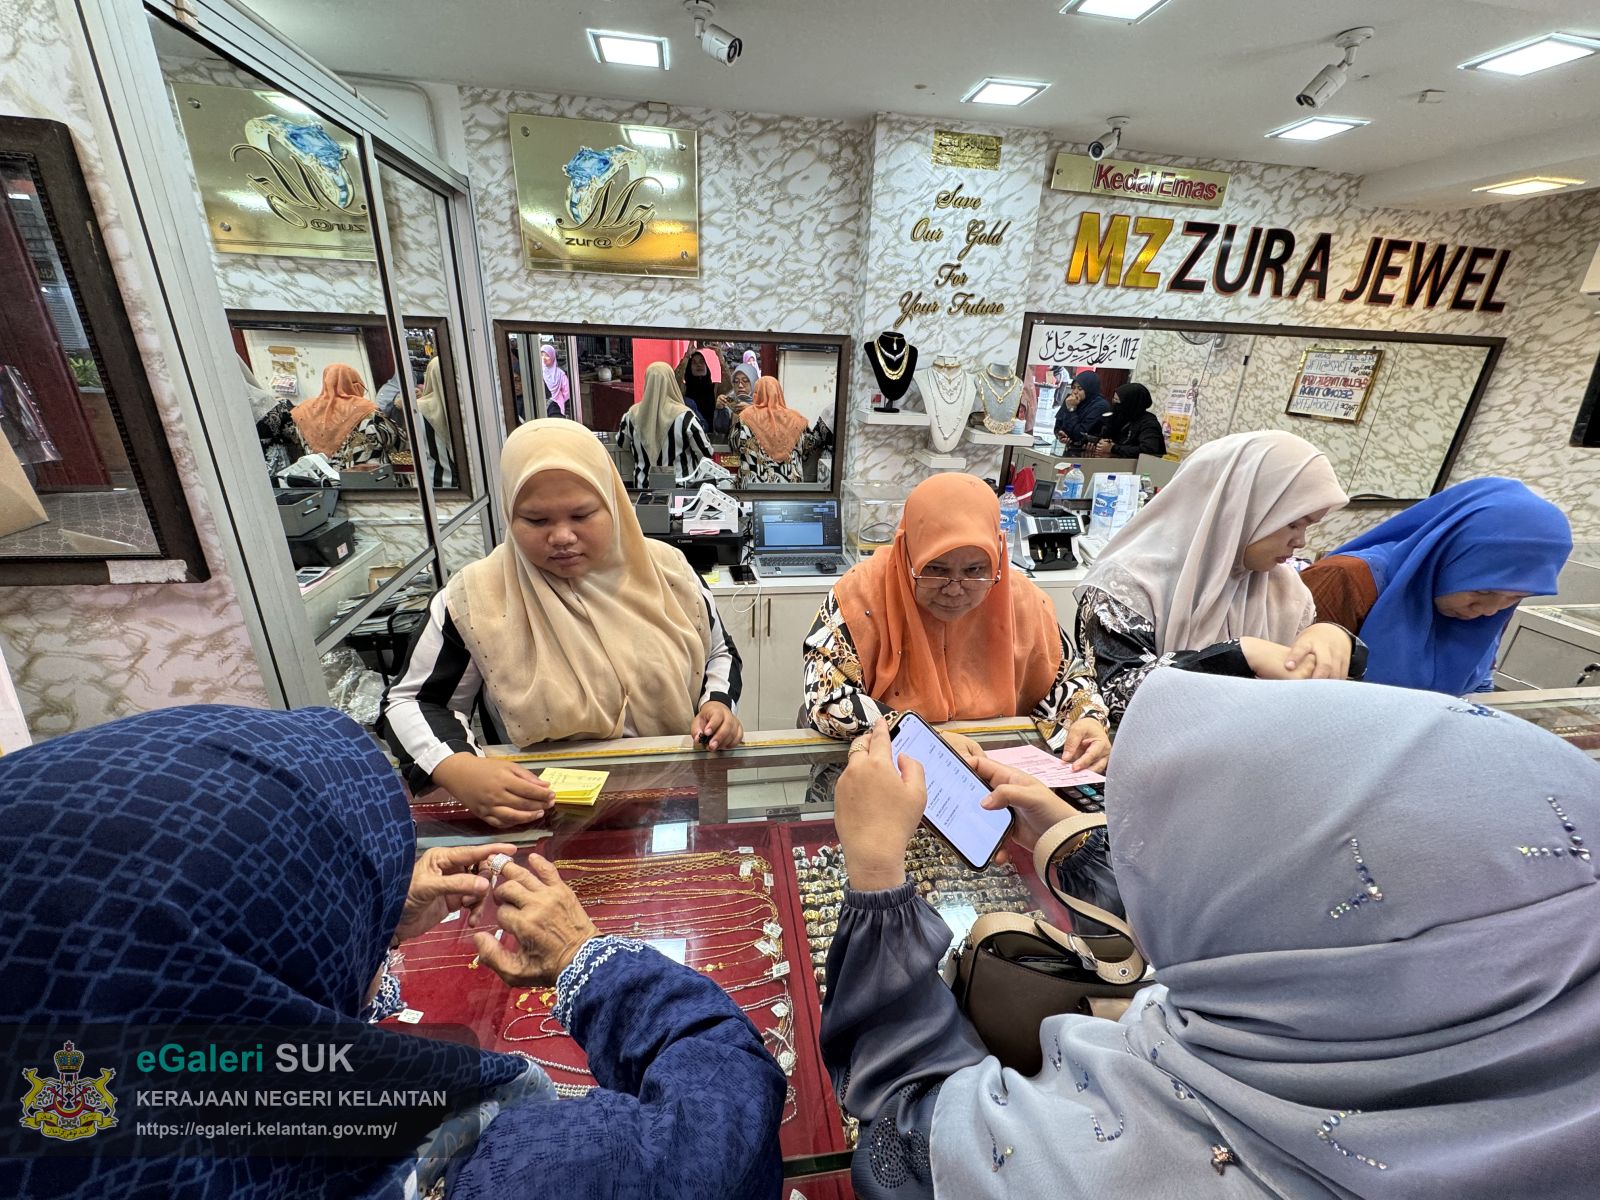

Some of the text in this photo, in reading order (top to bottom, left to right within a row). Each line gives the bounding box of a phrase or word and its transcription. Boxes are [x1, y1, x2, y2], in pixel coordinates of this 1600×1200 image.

[934, 183, 982, 211] Save
[1093, 163, 1218, 201] Kedai Emas
[565, 236, 613, 249] zur@
[910, 217, 1012, 261] Our Gold
[934, 262, 969, 288] For
[1065, 211, 1511, 313] MZ ZURA JEWEL
[893, 290, 1005, 329] Your Future
